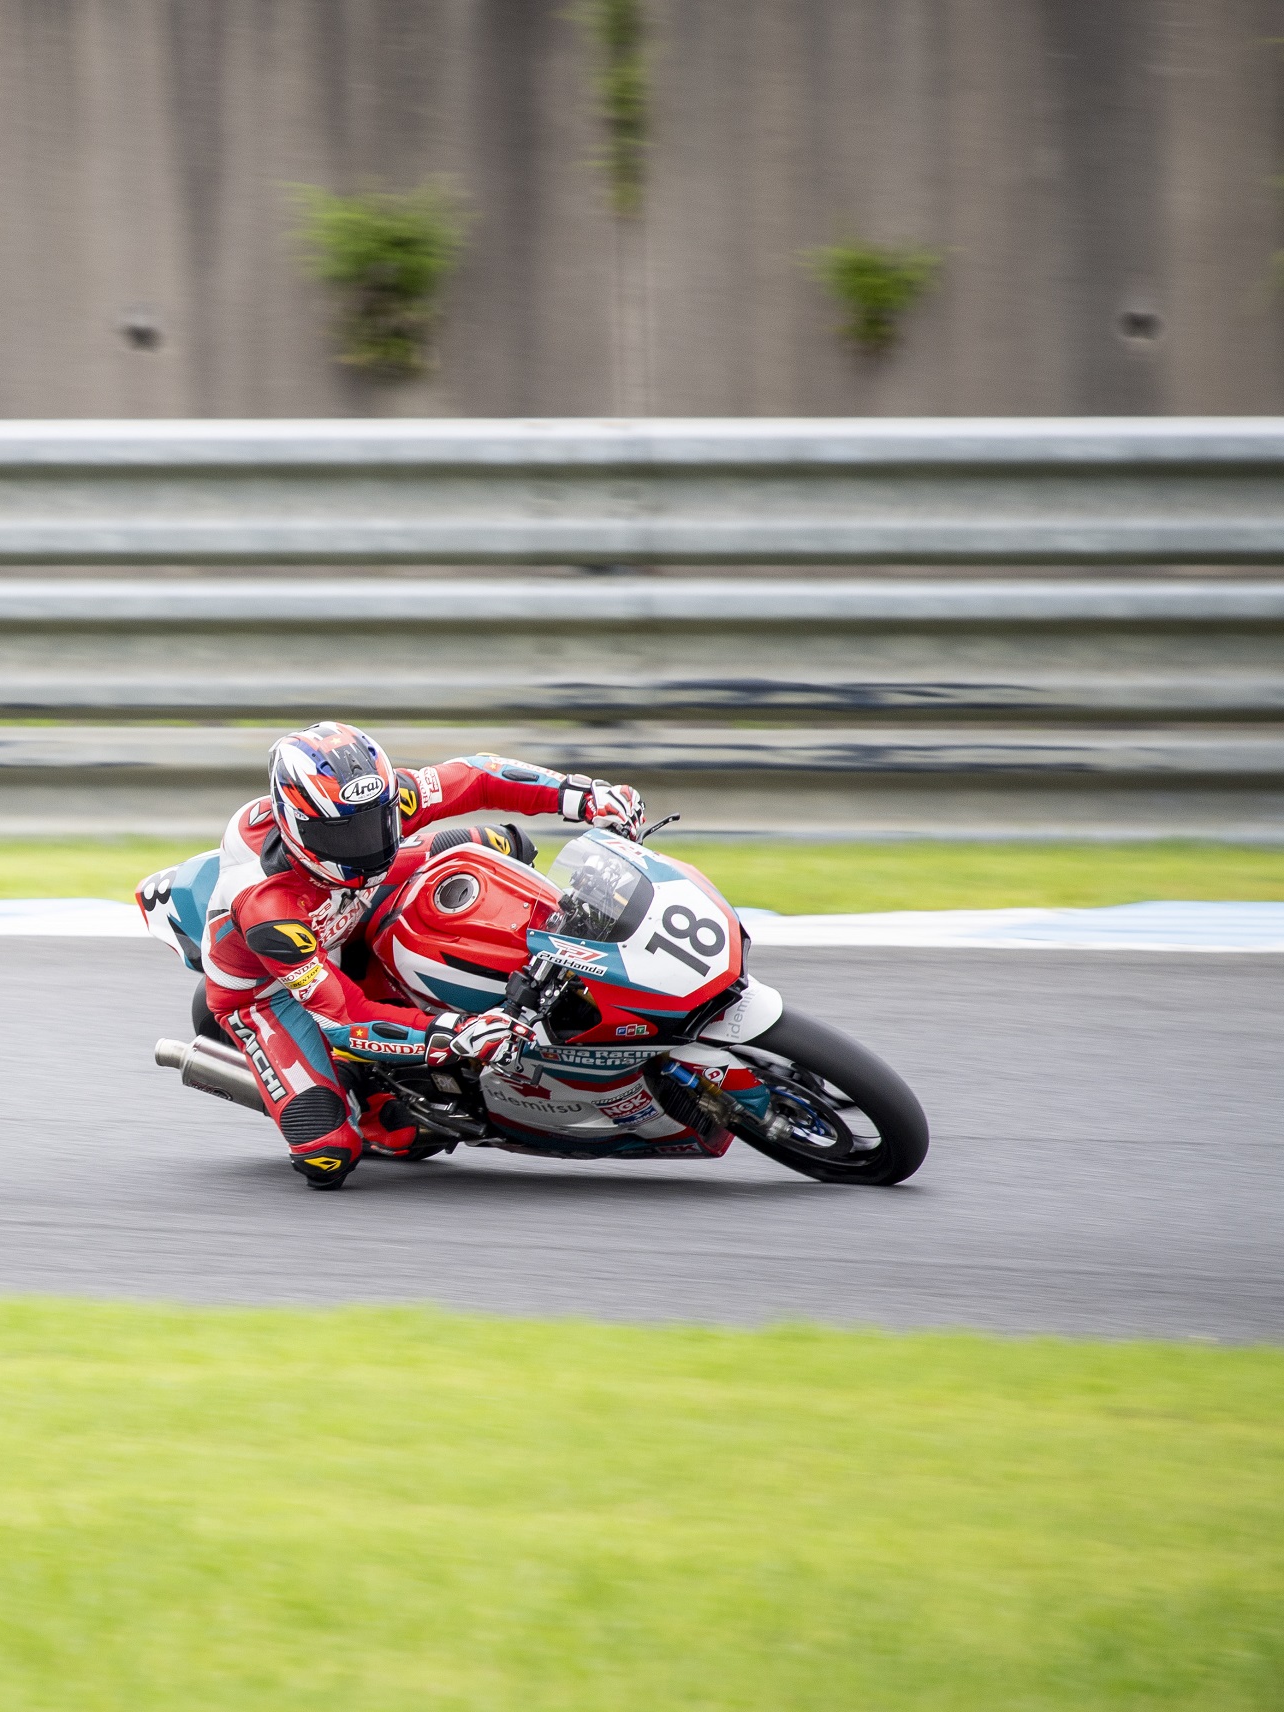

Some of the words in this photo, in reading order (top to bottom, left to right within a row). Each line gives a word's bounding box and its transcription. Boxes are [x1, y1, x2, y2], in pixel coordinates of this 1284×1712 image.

[345, 778, 380, 800] Arai
[644, 904, 726, 978] 18
[280, 961, 317, 983] HONDA
[292, 966, 320, 988] DUNLOP
[616, 1025, 647, 1036] FPT
[227, 1009, 287, 1102] TAICHI
[350, 1040, 425, 1054] HONDA
[485, 1085, 582, 1113] idemitsu
[603, 1092, 647, 1115] NGK
